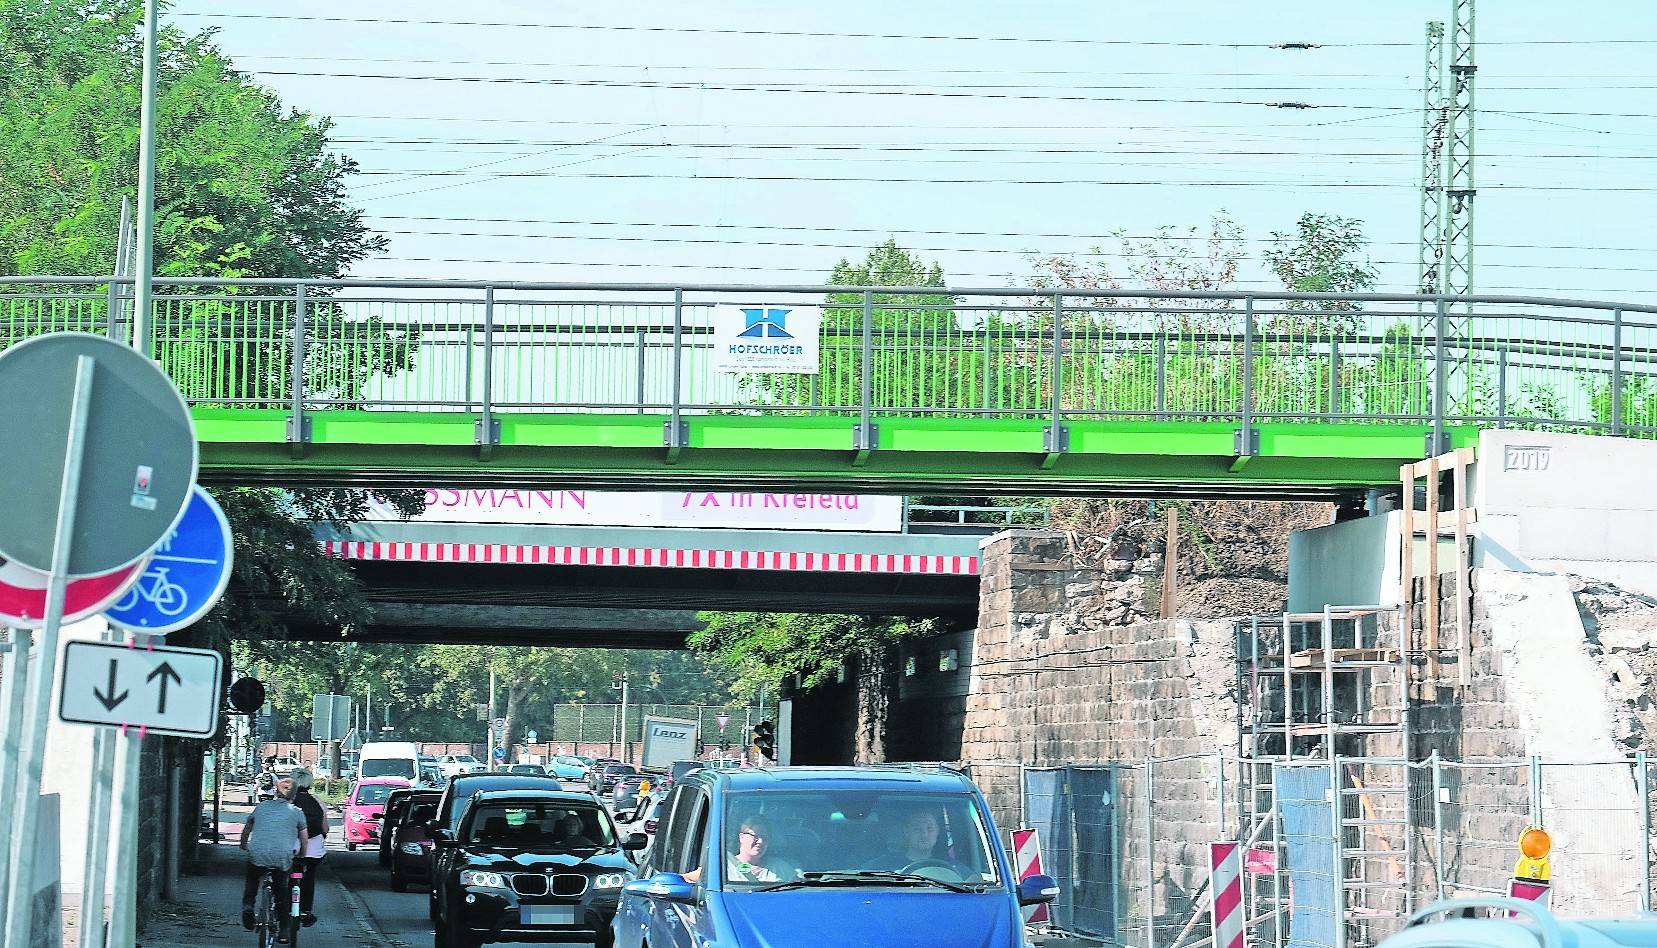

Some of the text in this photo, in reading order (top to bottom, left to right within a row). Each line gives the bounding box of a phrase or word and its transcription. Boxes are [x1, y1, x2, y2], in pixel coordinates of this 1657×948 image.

[729, 344, 803, 355] HOFSCHRÖER
[1507, 451, 1550, 470] 2019
[653, 727, 687, 739] Lenz
